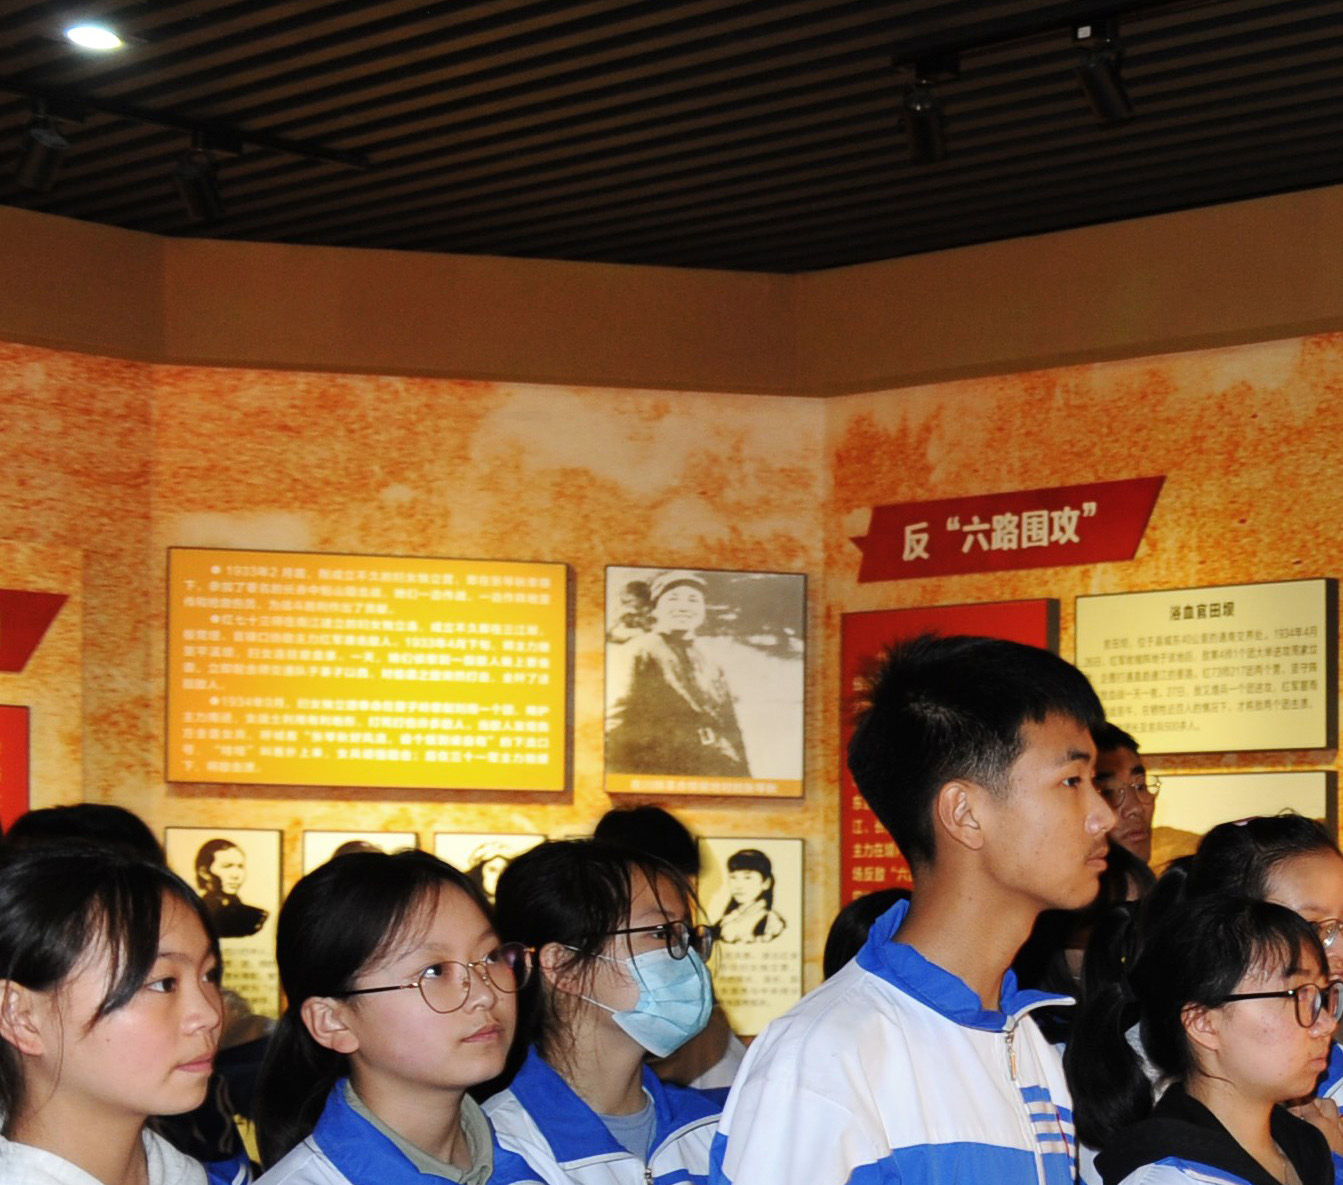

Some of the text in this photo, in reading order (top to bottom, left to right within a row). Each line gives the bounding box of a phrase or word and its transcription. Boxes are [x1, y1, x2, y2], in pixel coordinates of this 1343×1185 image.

[901, 500, 1098, 562] 反“六路围攻”
